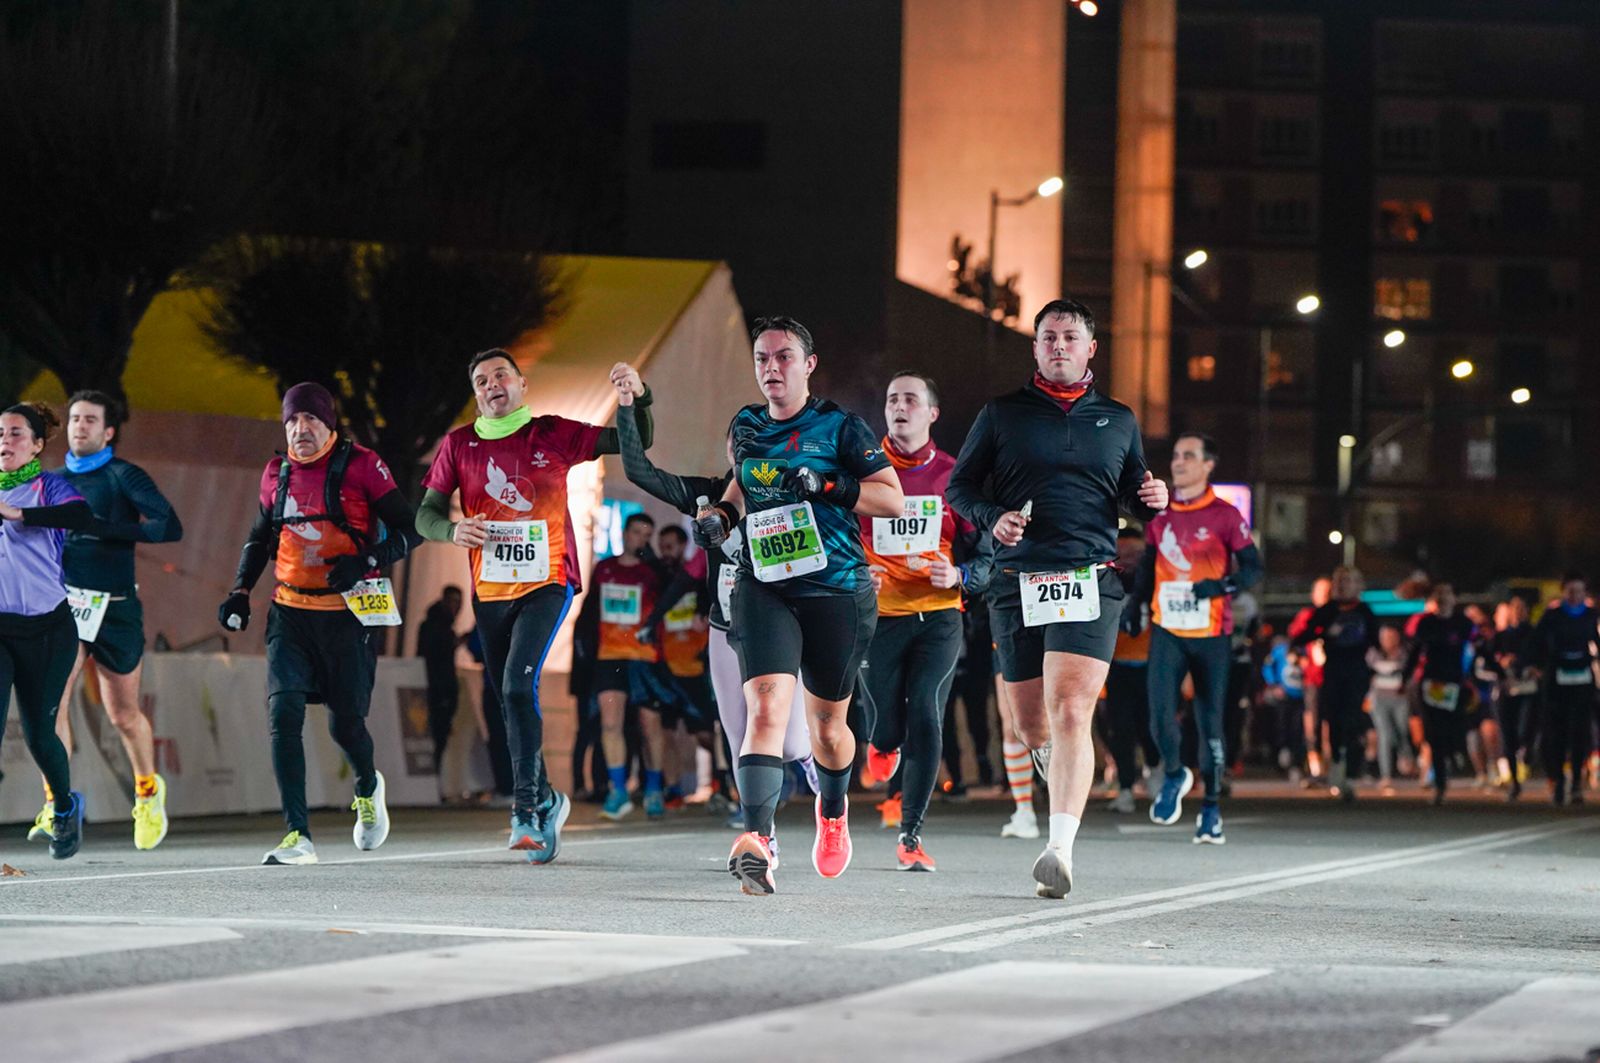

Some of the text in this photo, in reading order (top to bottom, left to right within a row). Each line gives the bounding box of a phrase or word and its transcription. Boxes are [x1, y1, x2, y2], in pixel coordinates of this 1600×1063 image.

[500, 488, 517, 504] 43
[776, 515, 785, 523] DE
[888, 518, 928, 535] 1097
[494, 543, 536, 562] 4766
[759, 529, 809, 559] 8692
[1037, 582, 1084, 603] 2674
[357, 594, 389, 612] 1235
